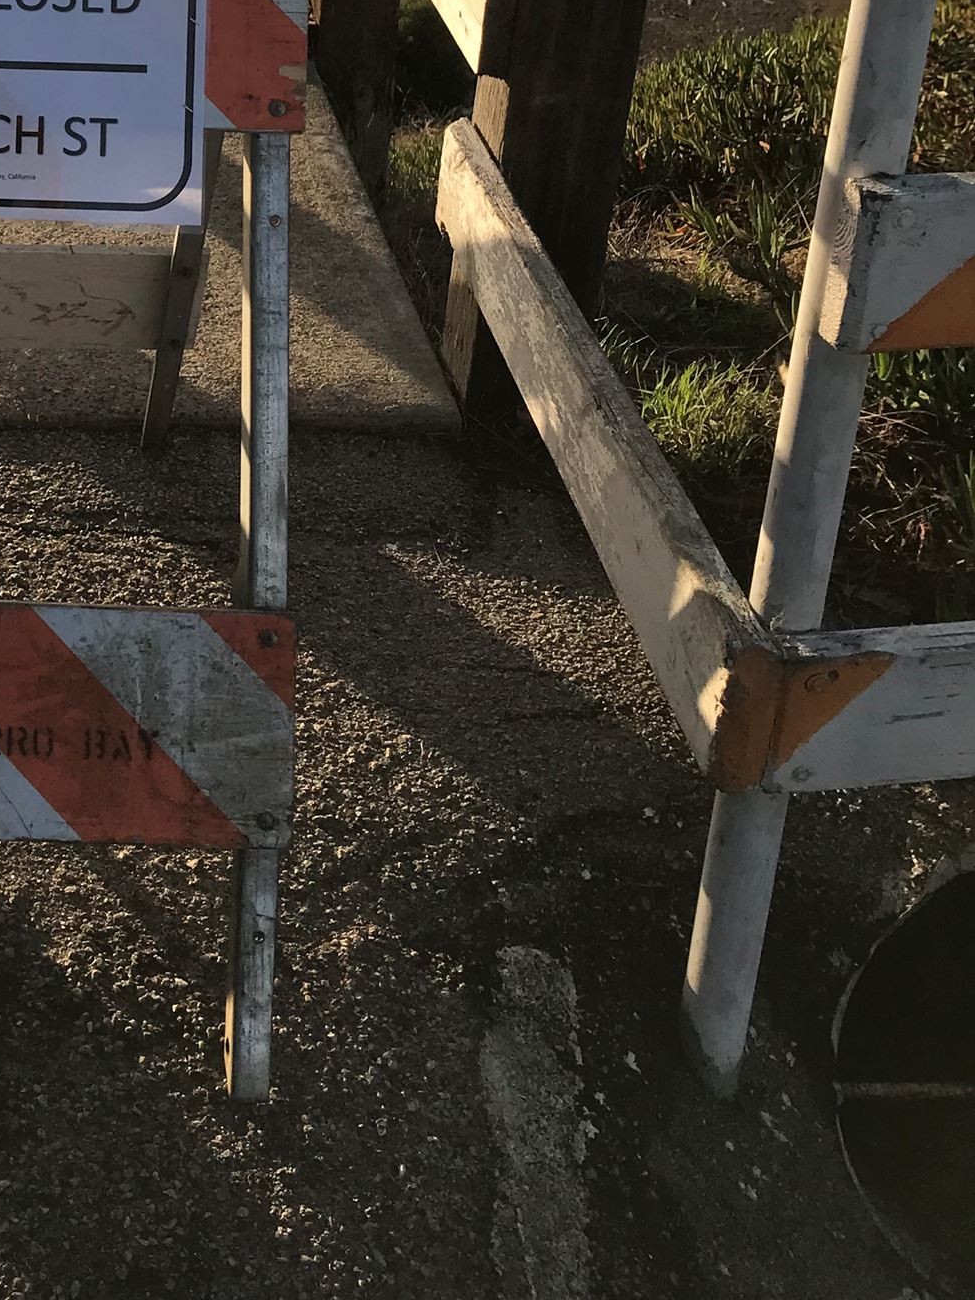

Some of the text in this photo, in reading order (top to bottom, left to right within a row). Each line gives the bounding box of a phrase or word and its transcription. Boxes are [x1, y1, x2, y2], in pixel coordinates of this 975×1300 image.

[62, 115, 119, 157] ST
[8, 173, 37, 181] California
[83, 728, 160, 762] BAY
